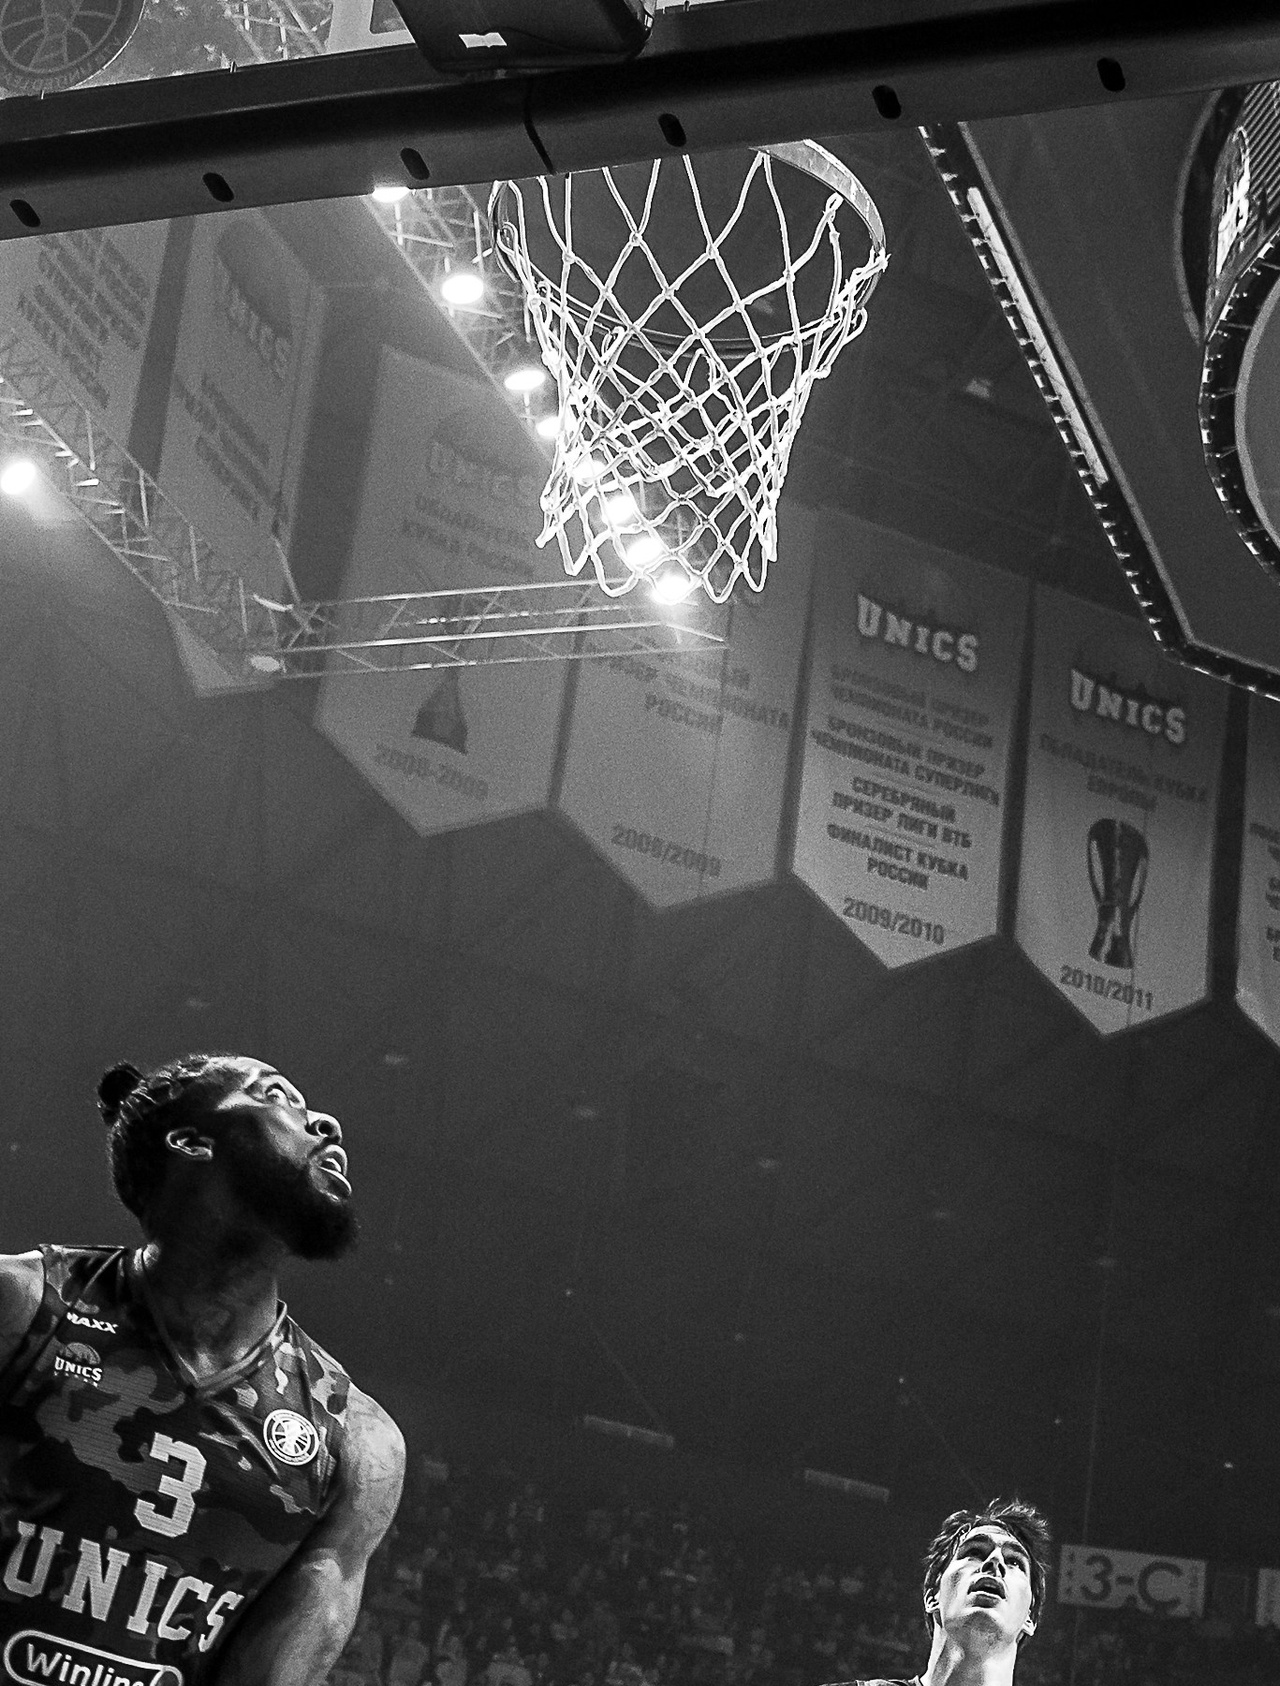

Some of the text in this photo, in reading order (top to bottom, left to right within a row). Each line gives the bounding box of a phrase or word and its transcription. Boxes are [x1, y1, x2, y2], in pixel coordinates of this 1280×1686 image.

[857, 592, 980, 673] UNICS
[1070, 668, 1187, 745] UNICS
[841, 896, 946, 945] 2009/2010
[1059, 963, 1154, 1012] 2010/2011
[54, 1355, 103, 1382] UNICS
[134, 1431, 207, 1538] 3
[2, 1520, 245, 1653] UNICS
